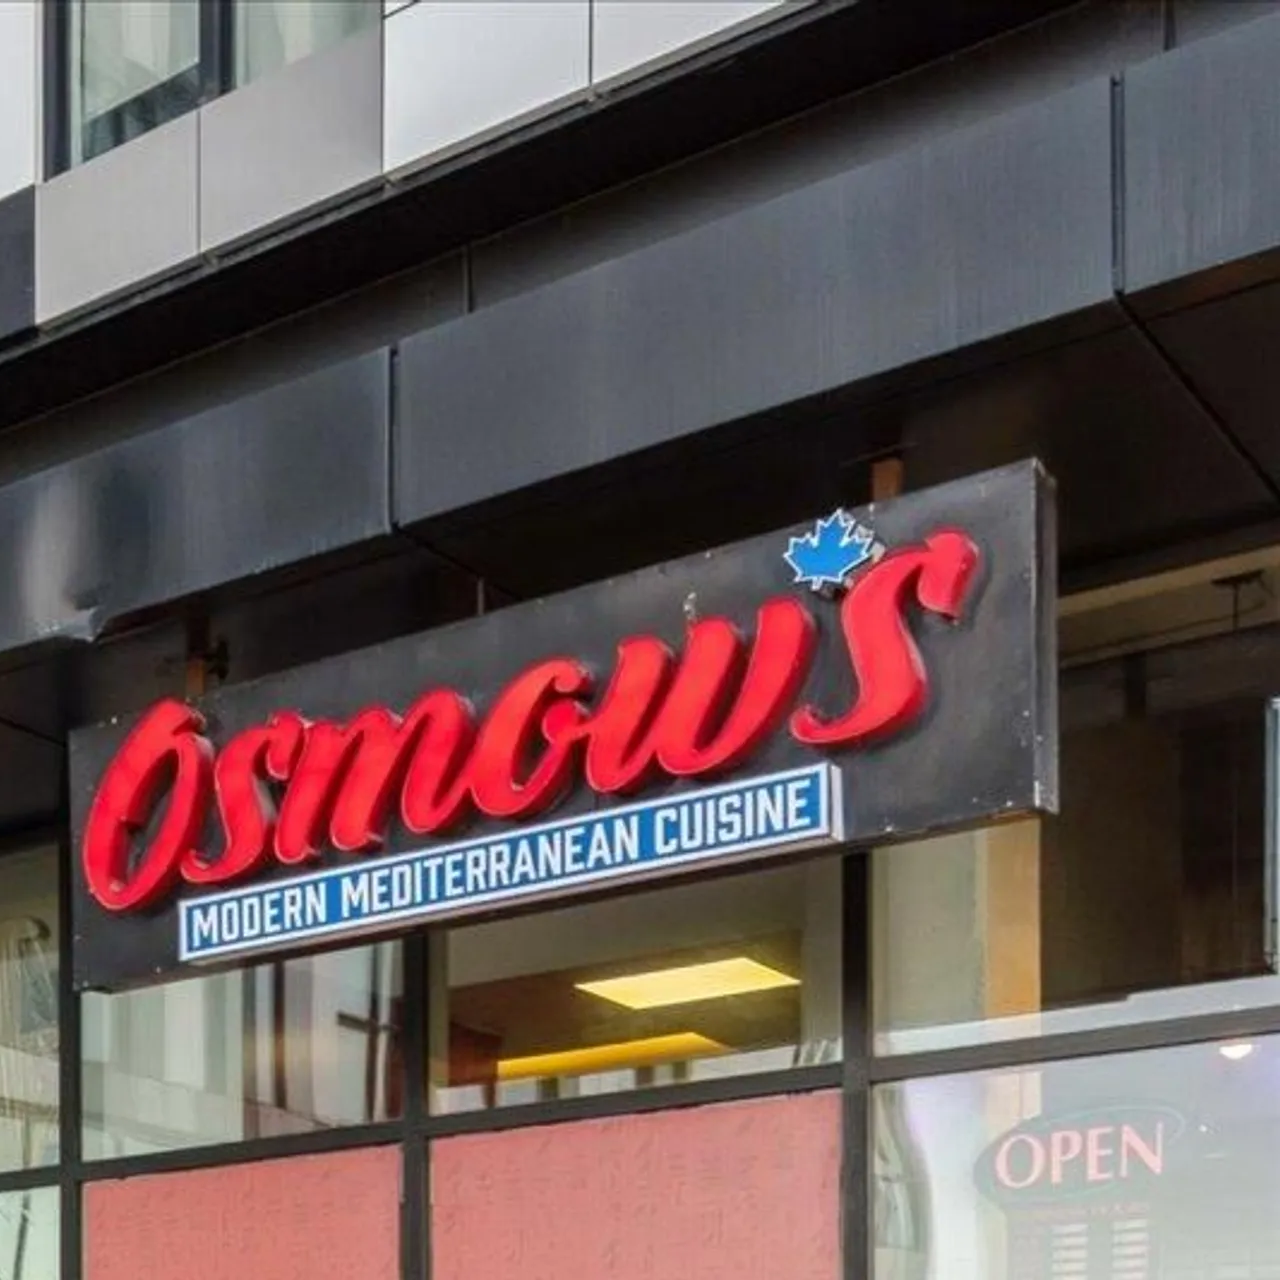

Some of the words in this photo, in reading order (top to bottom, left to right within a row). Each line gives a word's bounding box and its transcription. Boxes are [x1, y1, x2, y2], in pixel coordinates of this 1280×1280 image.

[192, 881, 328, 949] MODERN
[340, 815, 640, 918] MEDITERRANEAN
[653, 778, 811, 856] CUISINE
[994, 1119, 1165, 1189] OPEN
